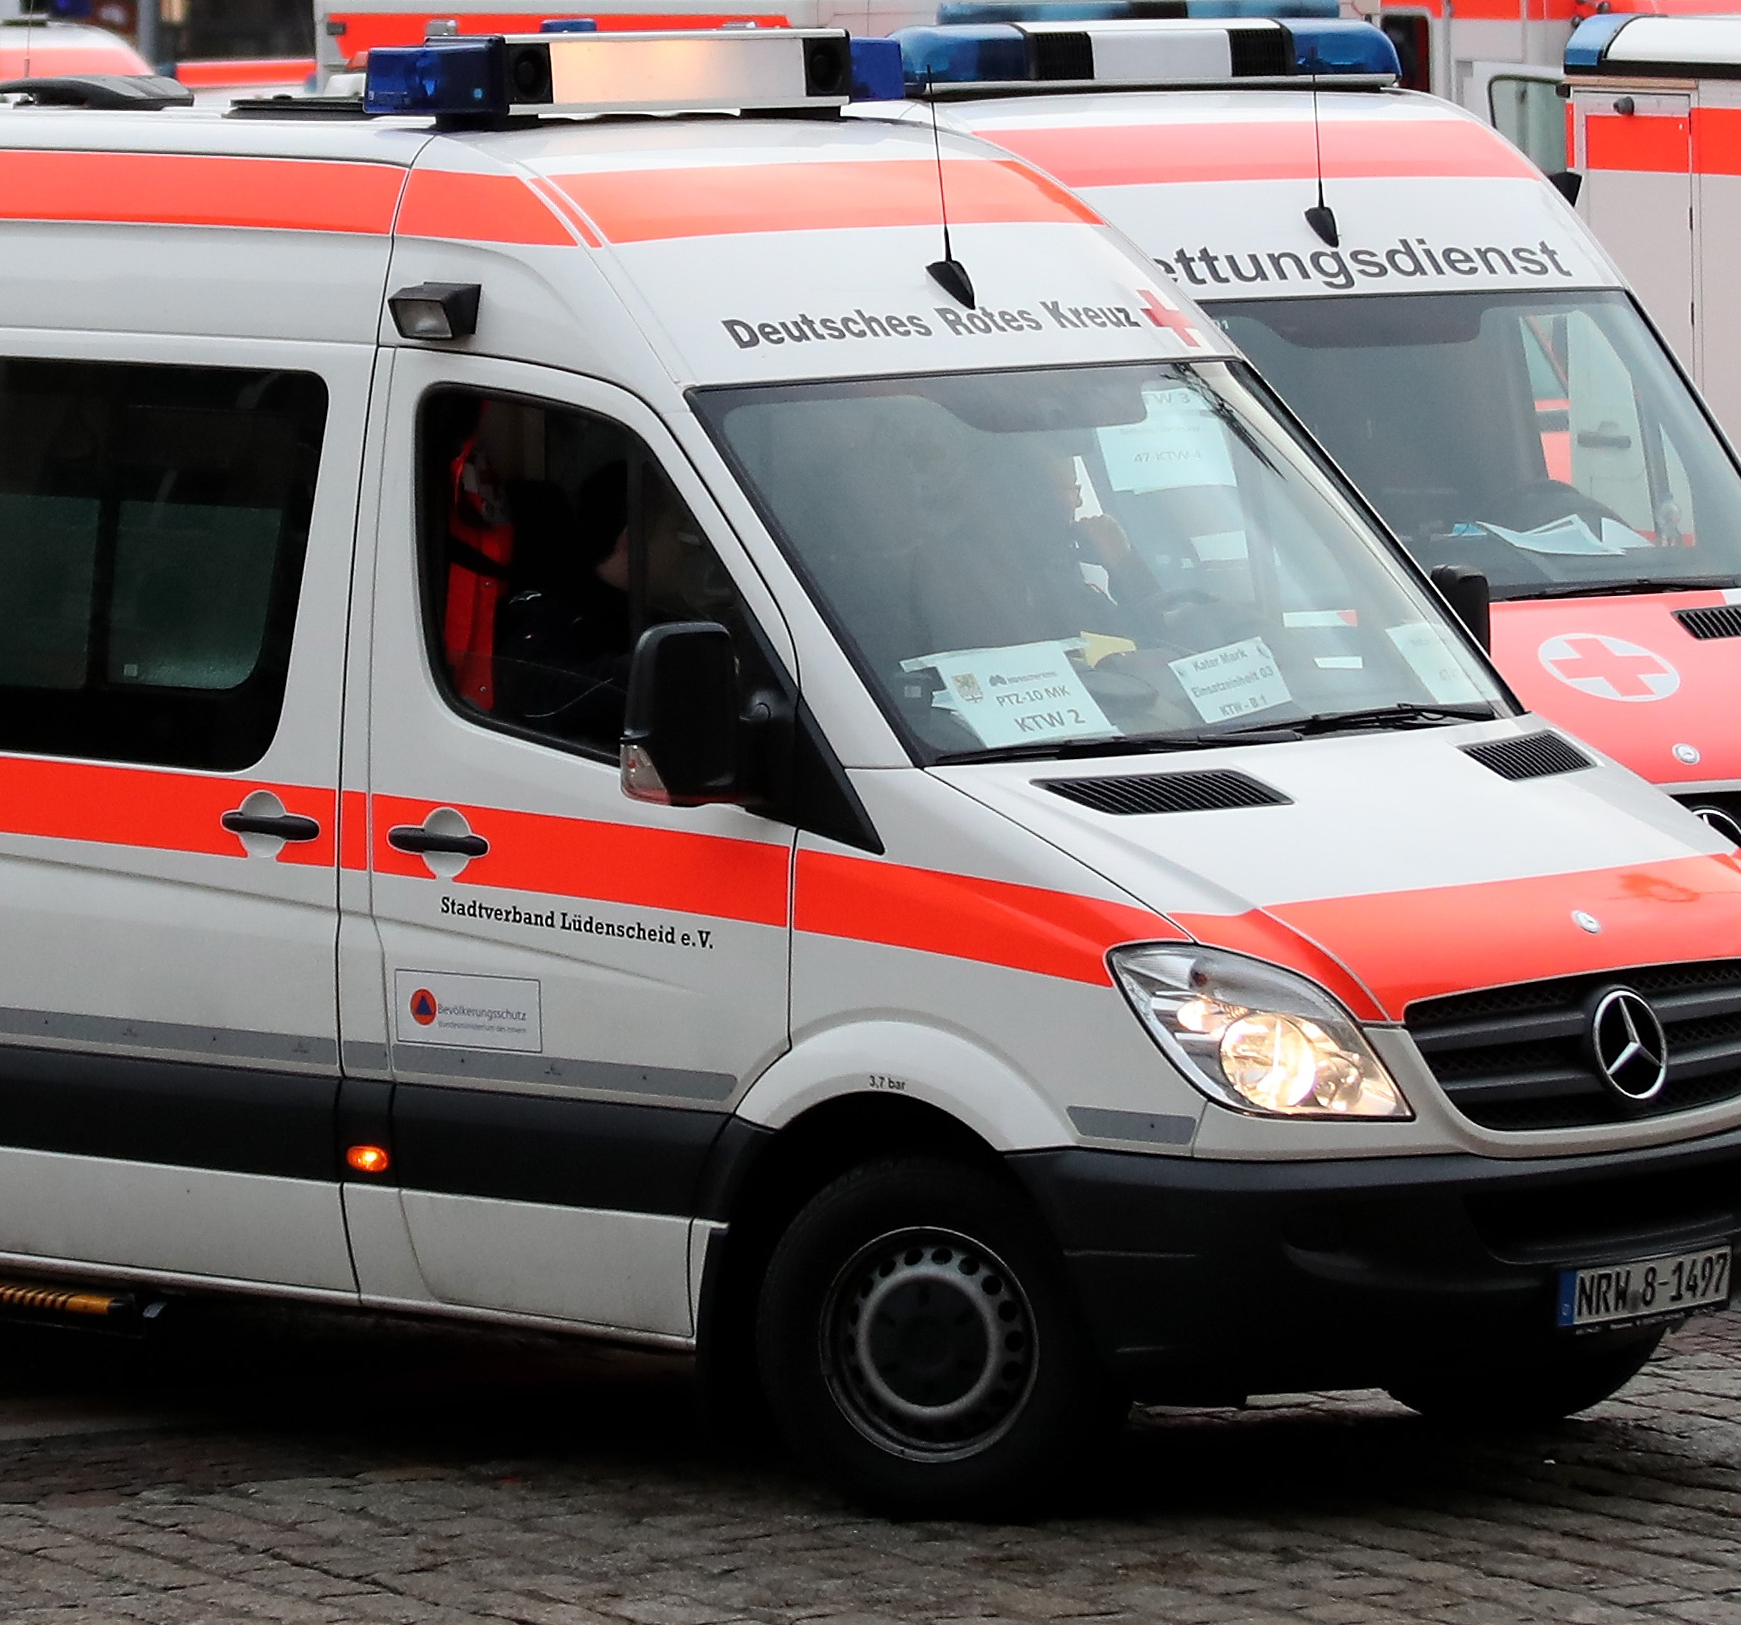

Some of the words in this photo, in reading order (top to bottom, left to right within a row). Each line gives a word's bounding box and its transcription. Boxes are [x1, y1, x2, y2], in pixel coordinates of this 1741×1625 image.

[1152, 239, 1573, 290] ettungsdienst
[721, 307, 933, 350] Deutsches
[935, 302, 1043, 337] Rotes
[1040, 301, 1140, 329] Kreuz
[1144, 393, 1173, 405] TW
[1179, 393, 1192, 404] 3
[996, 689, 1044, 708] PTZ-10
[1044, 684, 1071, 699] MK
[1013, 710, 1066, 733] KTW
[1067, 708, 1087, 725] 2
[440, 896, 556, 930] Stadtverband
[559, 909, 677, 945] Lüdenscheid
[680, 927, 715, 950] e.V.
[438, 1003, 527, 1022] Bevölkerungsschutz
[887, 1077, 906, 1090] bar
[1576, 1269, 1631, 1317] NRW
